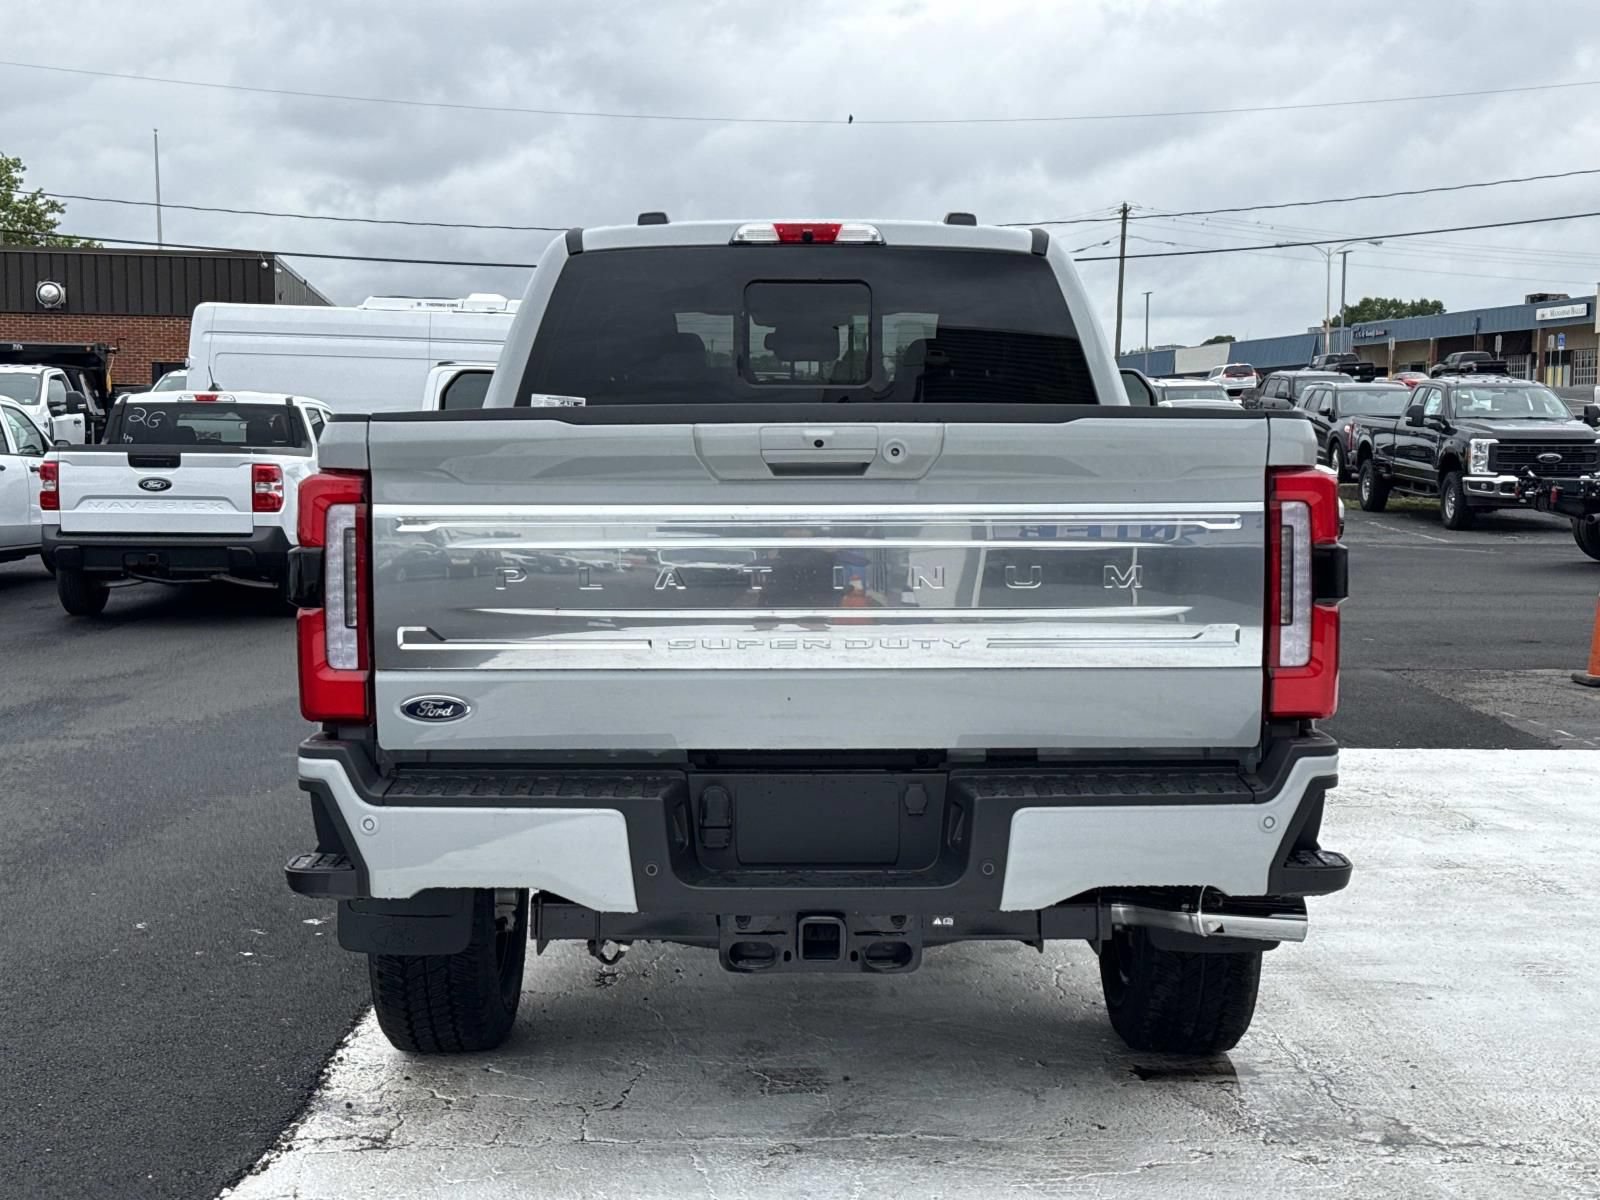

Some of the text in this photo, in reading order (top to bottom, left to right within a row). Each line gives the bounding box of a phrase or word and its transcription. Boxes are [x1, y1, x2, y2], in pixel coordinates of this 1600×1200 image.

[495, 564, 1143, 590] PLATINUM
[667, 637, 970, 650] SUPER DUTY
[416, 700, 454, 717] Ford
